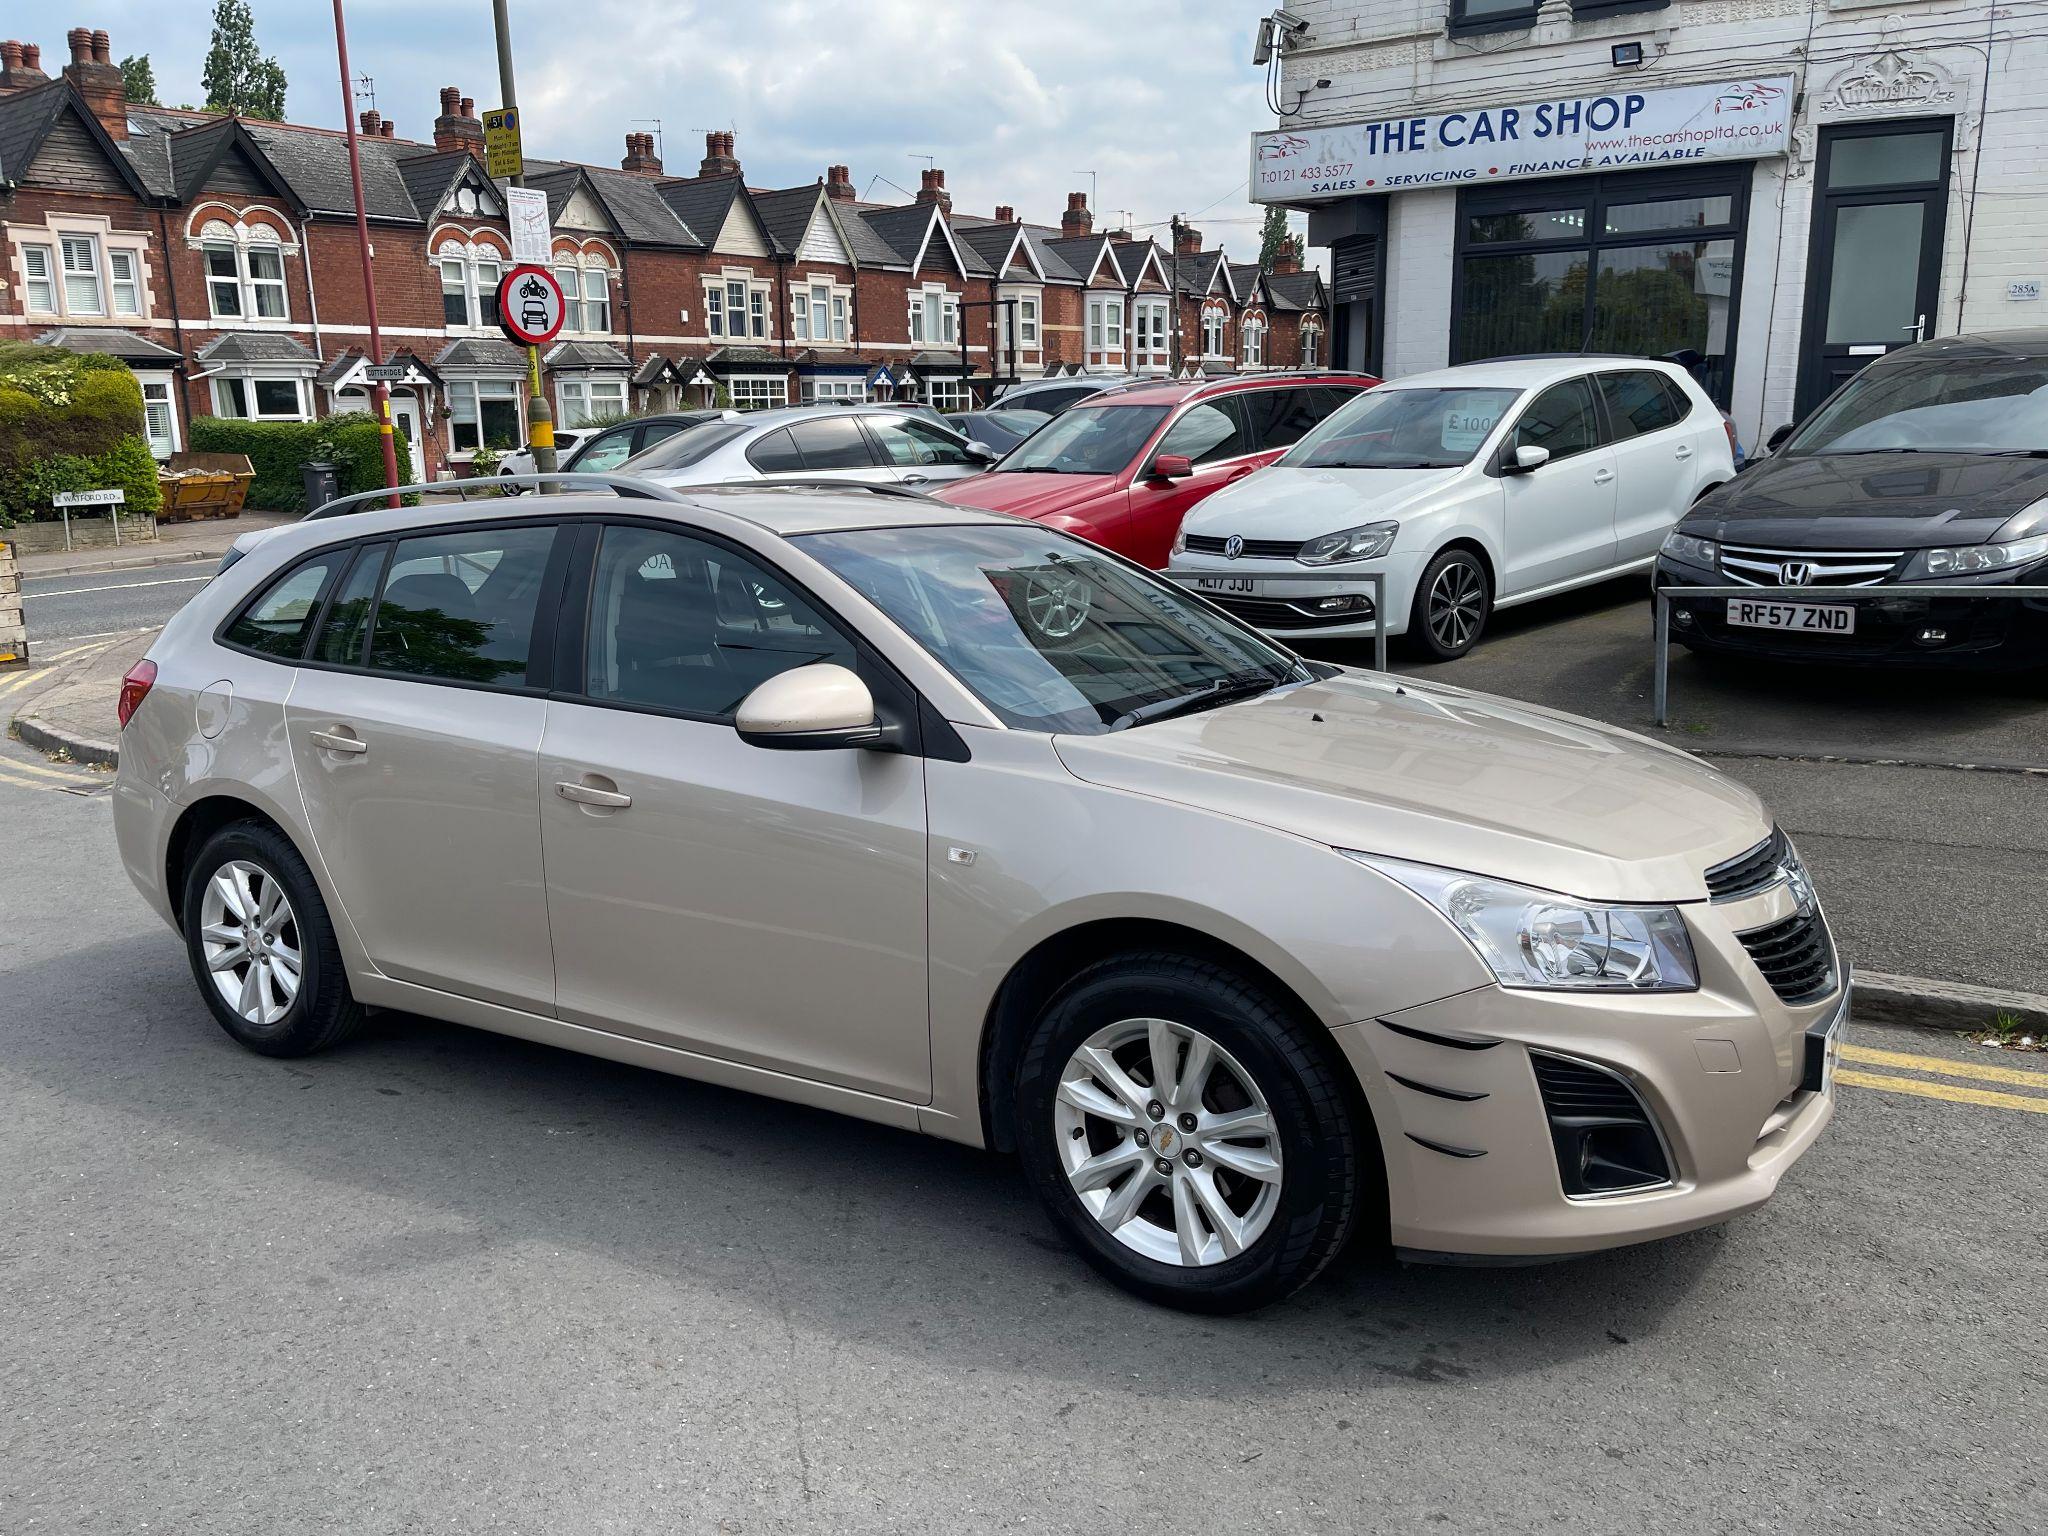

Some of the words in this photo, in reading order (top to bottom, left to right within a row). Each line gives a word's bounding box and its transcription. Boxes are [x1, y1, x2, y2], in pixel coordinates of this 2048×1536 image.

[1366, 118, 1426, 155] THE
[1438, 108, 1520, 147] CAR
[1533, 94, 1645, 138] SHOP
[1585, 121, 1783, 151] www.thecarshopltd.co.uk
[1508, 157, 1593, 175] FINANCE
[1598, 147, 1706, 166] AVAILABLE
[1260, 170, 1296, 184] T:0121
[1300, 167, 1321, 180] 433
[1323, 163, 1354, 179] 5577
[1384, 168, 1478, 186] SERVICING
[1310, 179, 1357, 193] SALES
[2011, 284, 2035, 293] 285A
[367, 368, 402, 377] COTTERIDGE
[63, 494, 102, 503] WATFORD
[103, 493, 116, 501] RD
[1740, 603, 1797, 627] RF57
[1802, 608, 1849, 630] ZND
